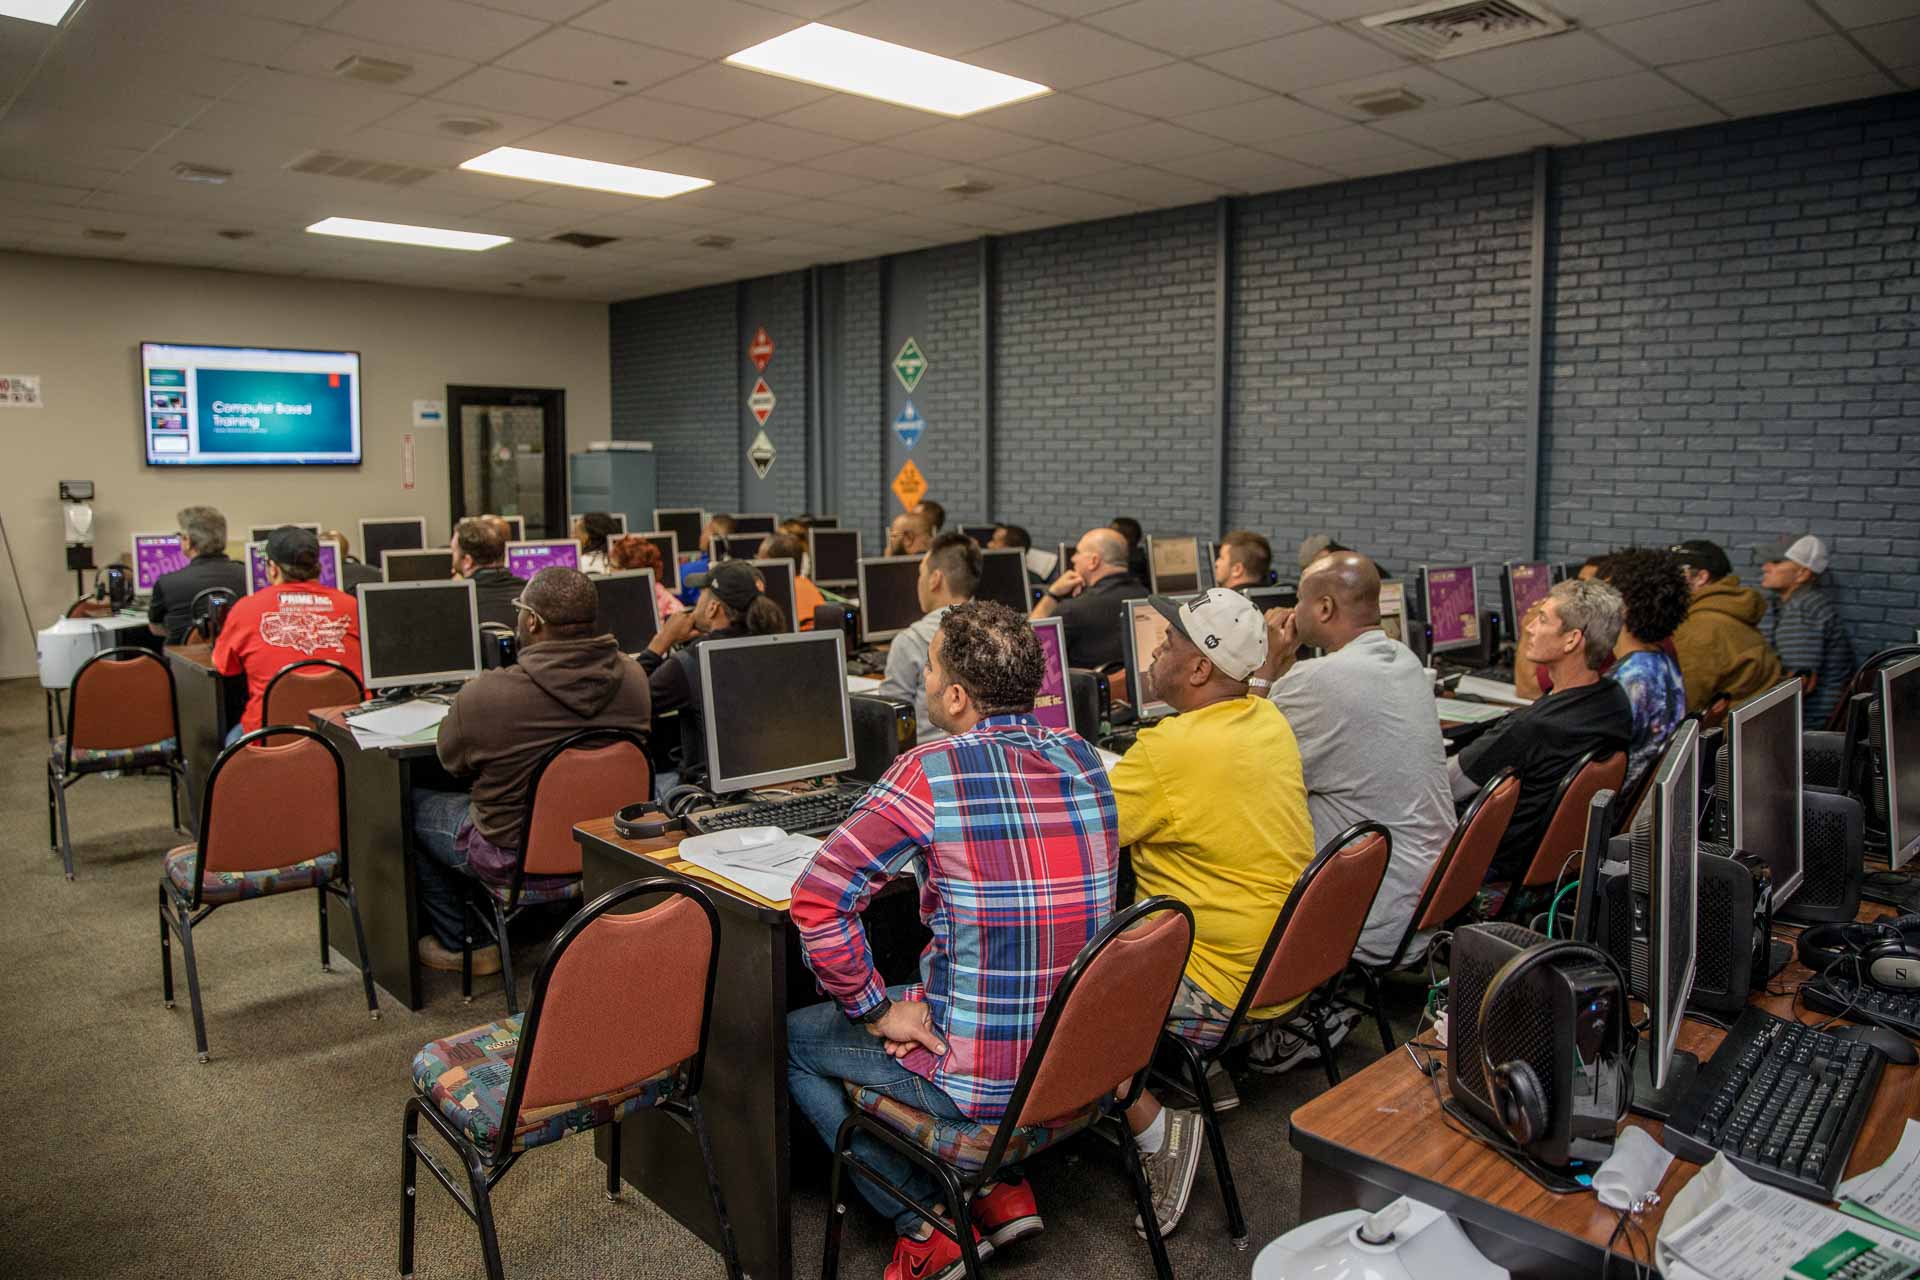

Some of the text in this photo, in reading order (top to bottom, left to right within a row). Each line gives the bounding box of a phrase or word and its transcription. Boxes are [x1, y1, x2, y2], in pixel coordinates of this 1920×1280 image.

[212, 401, 312, 415] Computer Based
[213, 415, 260, 430] Training
[279, 593, 314, 606] PRIME
